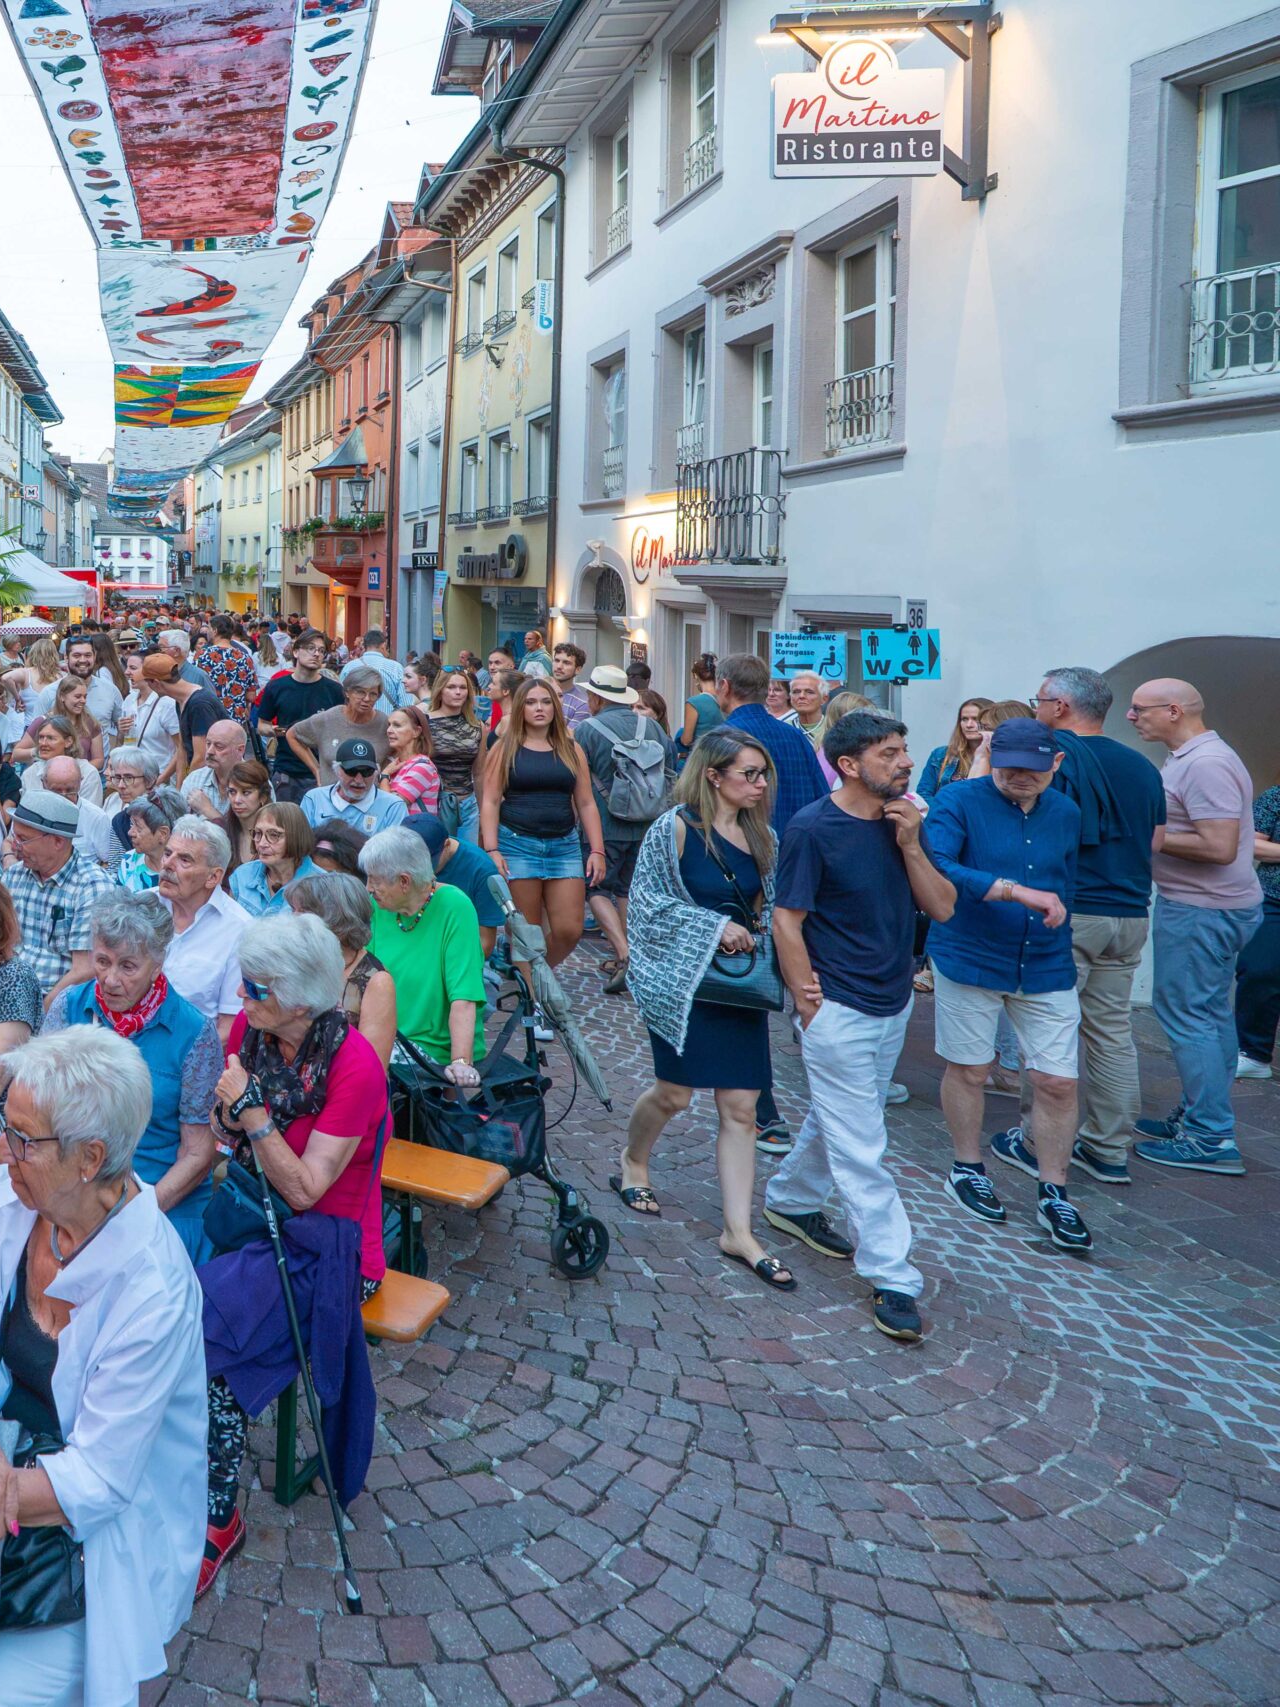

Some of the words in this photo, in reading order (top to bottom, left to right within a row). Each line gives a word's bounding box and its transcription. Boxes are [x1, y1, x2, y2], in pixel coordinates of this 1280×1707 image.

[840, 52, 878, 85] il
[782, 95, 940, 136] Martino
[783, 137, 933, 161] Ristorante
[909, 608, 923, 629] 36
[775, 633, 837, 642] Behinderten-WC
[775, 648, 815, 657] Korngasse
